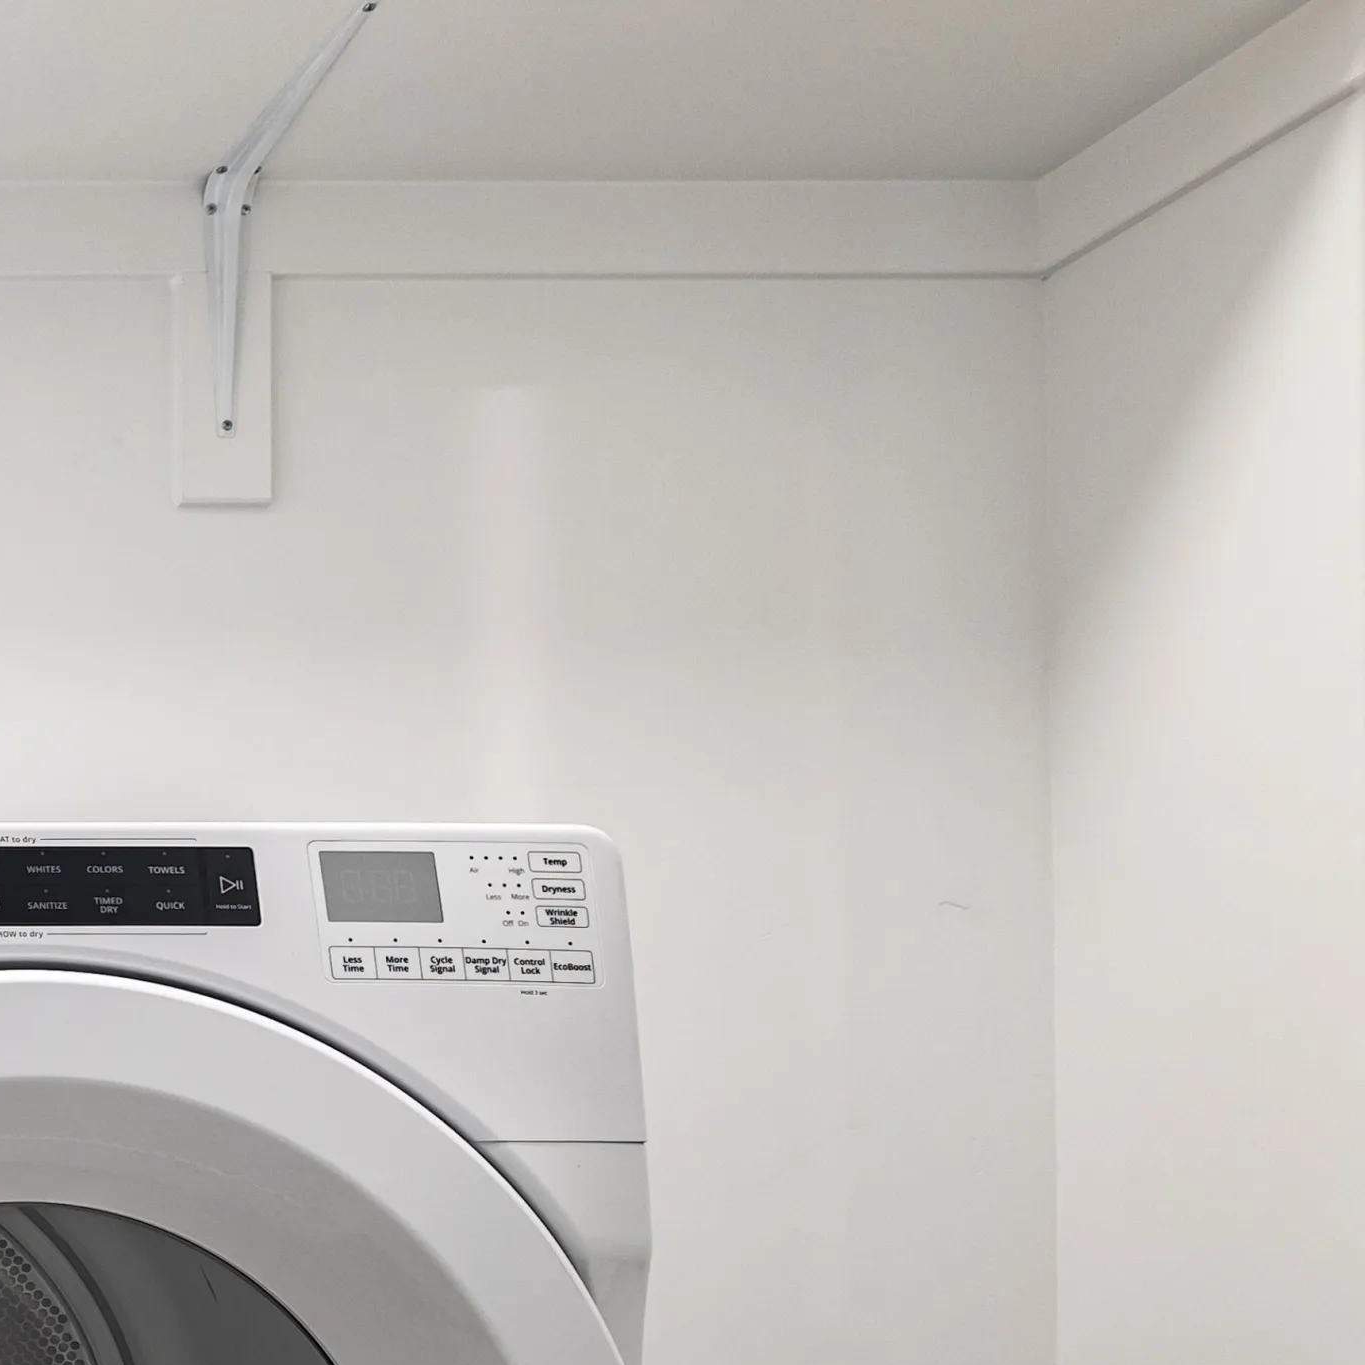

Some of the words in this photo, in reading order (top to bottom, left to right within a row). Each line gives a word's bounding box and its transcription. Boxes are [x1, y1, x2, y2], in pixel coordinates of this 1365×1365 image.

[22, 836, 36, 844] dry
[543, 858, 568, 867] Temp
[26, 865, 61, 874] WHITES
[87, 865, 124, 874] COLORS
[148, 866, 185, 875] TOWELS
[509, 868, 525, 876] High
[541, 885, 576, 894] Dryness
[94, 896, 123, 905] TIMED
[27, 902, 68, 910] SANITIZE
[100, 905, 119, 914] DRY
[156, 902, 185, 911] QUICK
[545, 909, 578, 917] Wrinkle
[29, 930, 44, 939] dry
[343, 956, 362, 964] Less
[386, 956, 409, 964] More
[430, 956, 453, 965] Cycle
[465, 956, 490, 966] Damp
[492, 957, 506, 966] Dry
[514, 958, 545, 966] Control
[429, 965, 456, 975] Signal
[475, 966, 500, 975] Signal
[553, 963, 592, 971] EcoBoost
